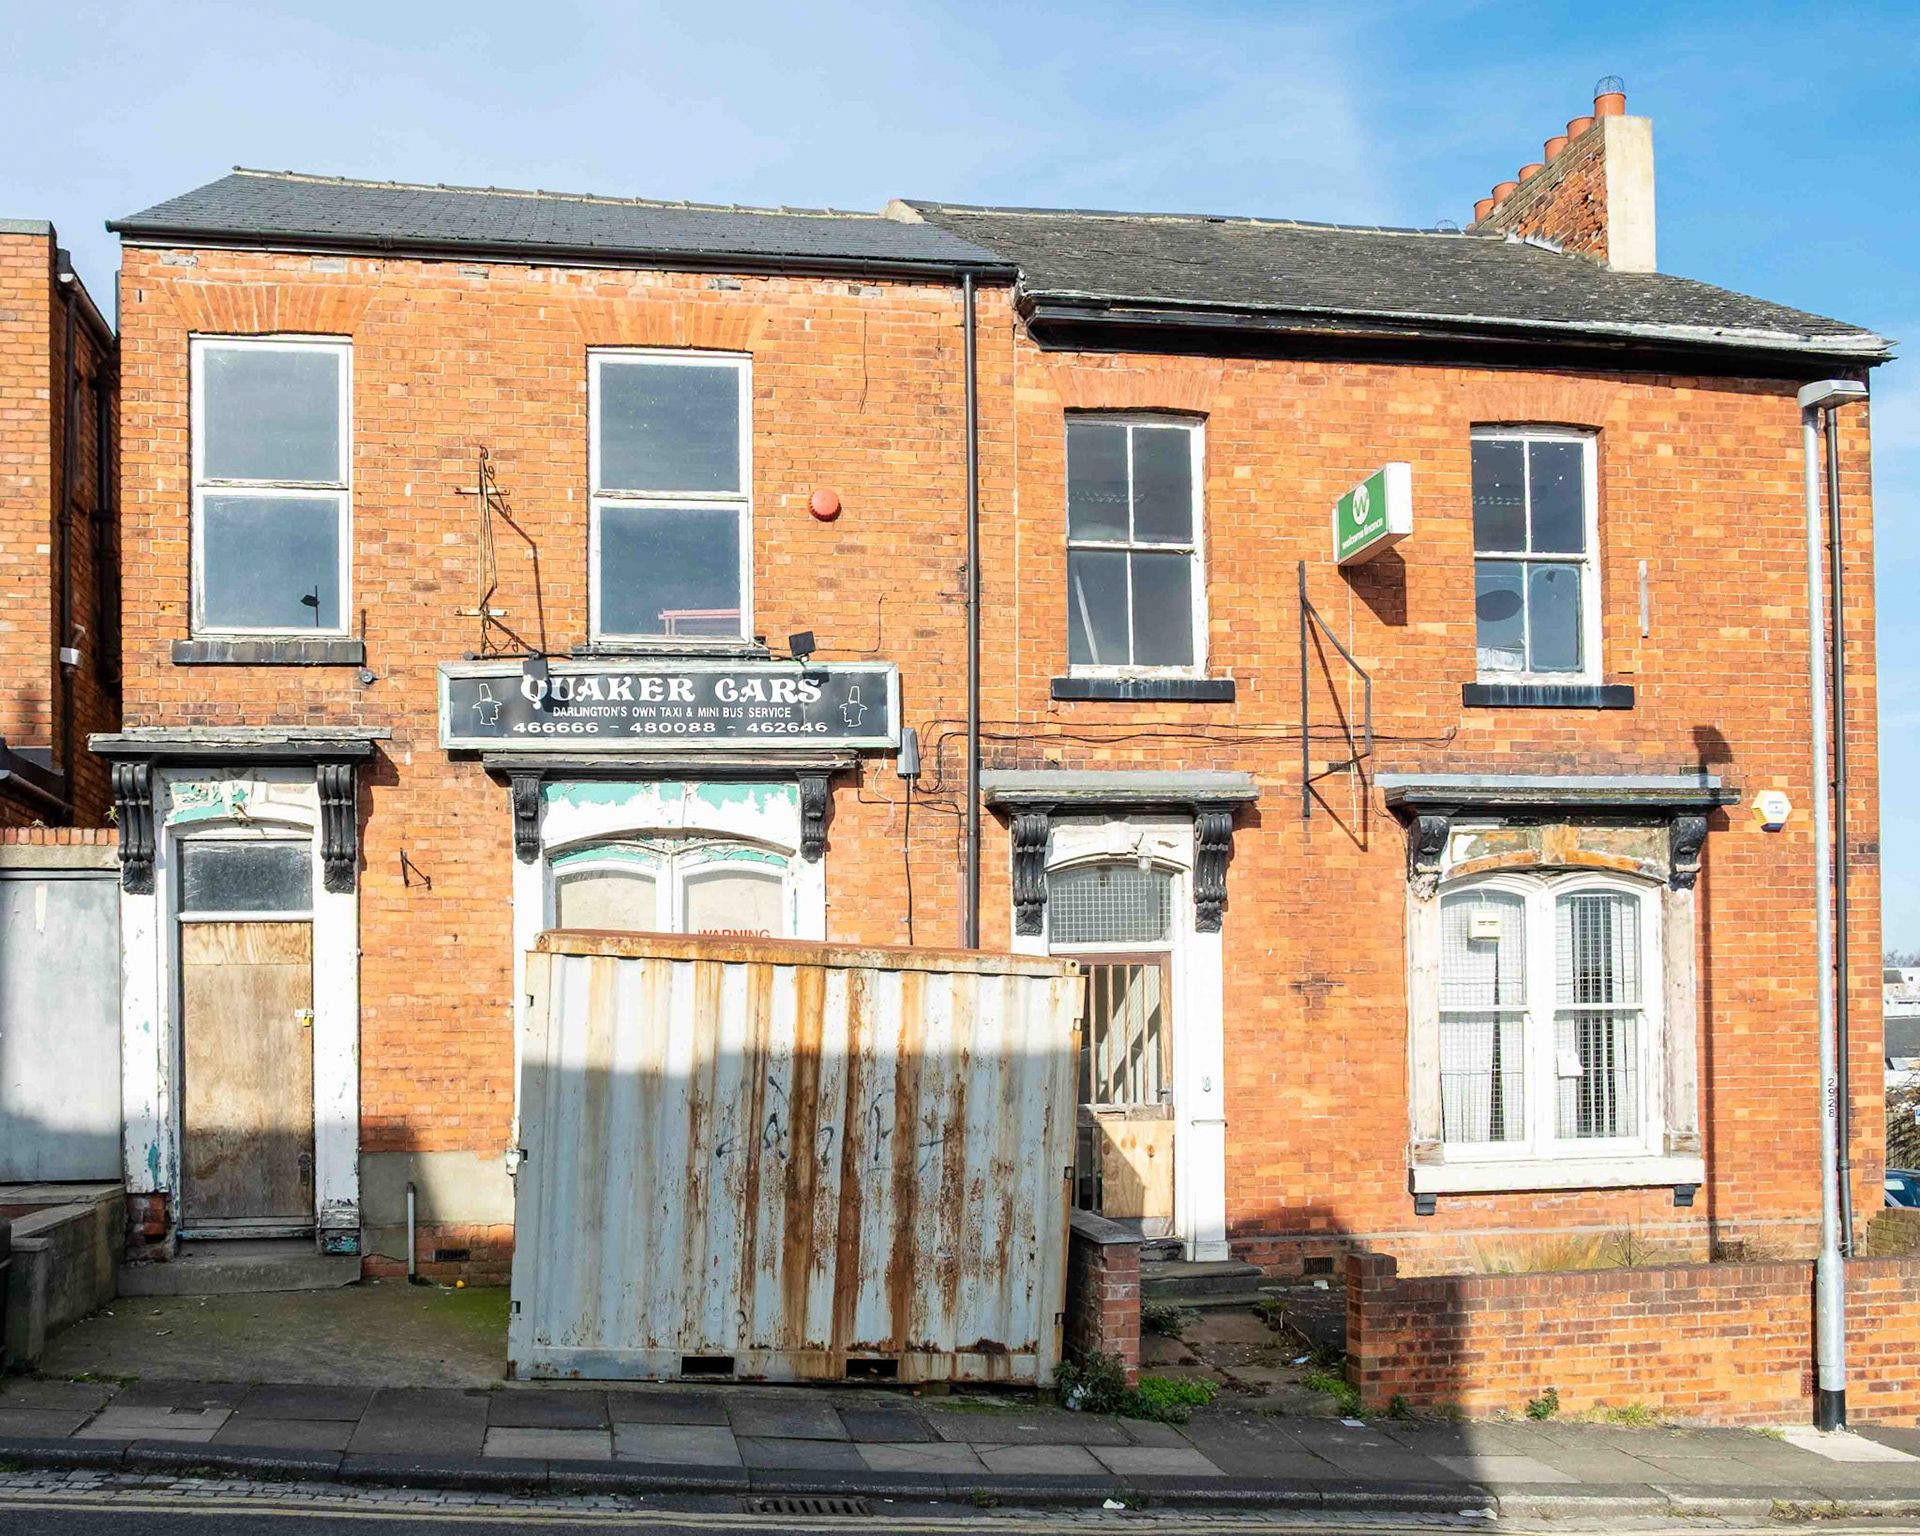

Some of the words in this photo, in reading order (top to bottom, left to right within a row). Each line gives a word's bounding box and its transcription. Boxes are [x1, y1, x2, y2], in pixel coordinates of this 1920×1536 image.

[521, 675, 696, 710] QUAKER
[715, 678, 821, 704] CARS
[553, 706, 627, 717] DARLINGTON'S
[632, 706, 656, 717] OWN
[660, 707, 682, 717] TAXI
[686, 707, 693, 717] &
[698, 707, 719, 717] MINI
[723, 707, 743, 717] BUS
[749, 707, 791, 717] SERVICE
[513, 722, 599, 733] 466666
[630, 722, 716, 733] 480088
[747, 722, 828, 733] 462646
